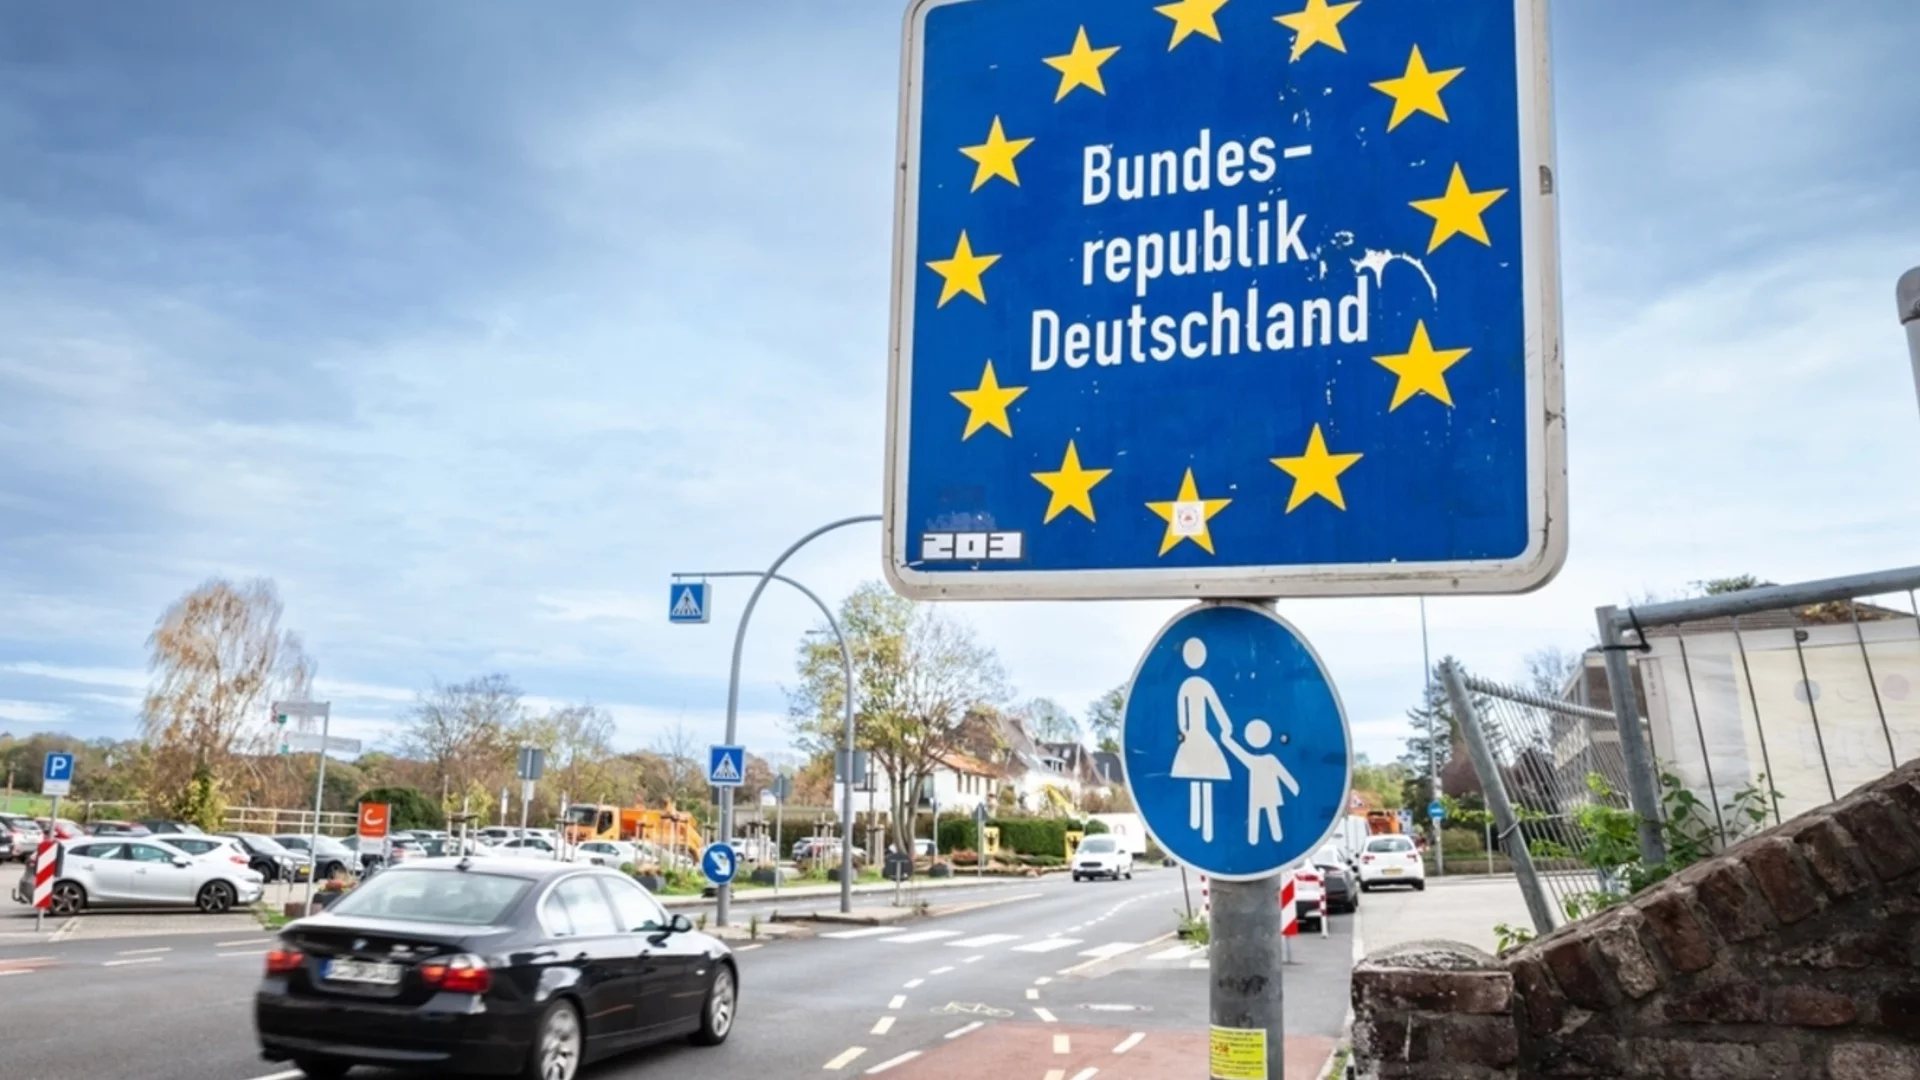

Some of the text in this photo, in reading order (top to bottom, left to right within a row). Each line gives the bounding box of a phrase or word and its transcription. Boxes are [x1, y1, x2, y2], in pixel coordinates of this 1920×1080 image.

[1082, 128, 1312, 206] Bundes-
[1082, 199, 1309, 297] republik
[1030, 275, 1369, 372] Deutschland
[922, 532, 1022, 560] 203
[50, 756, 68, 778] P
